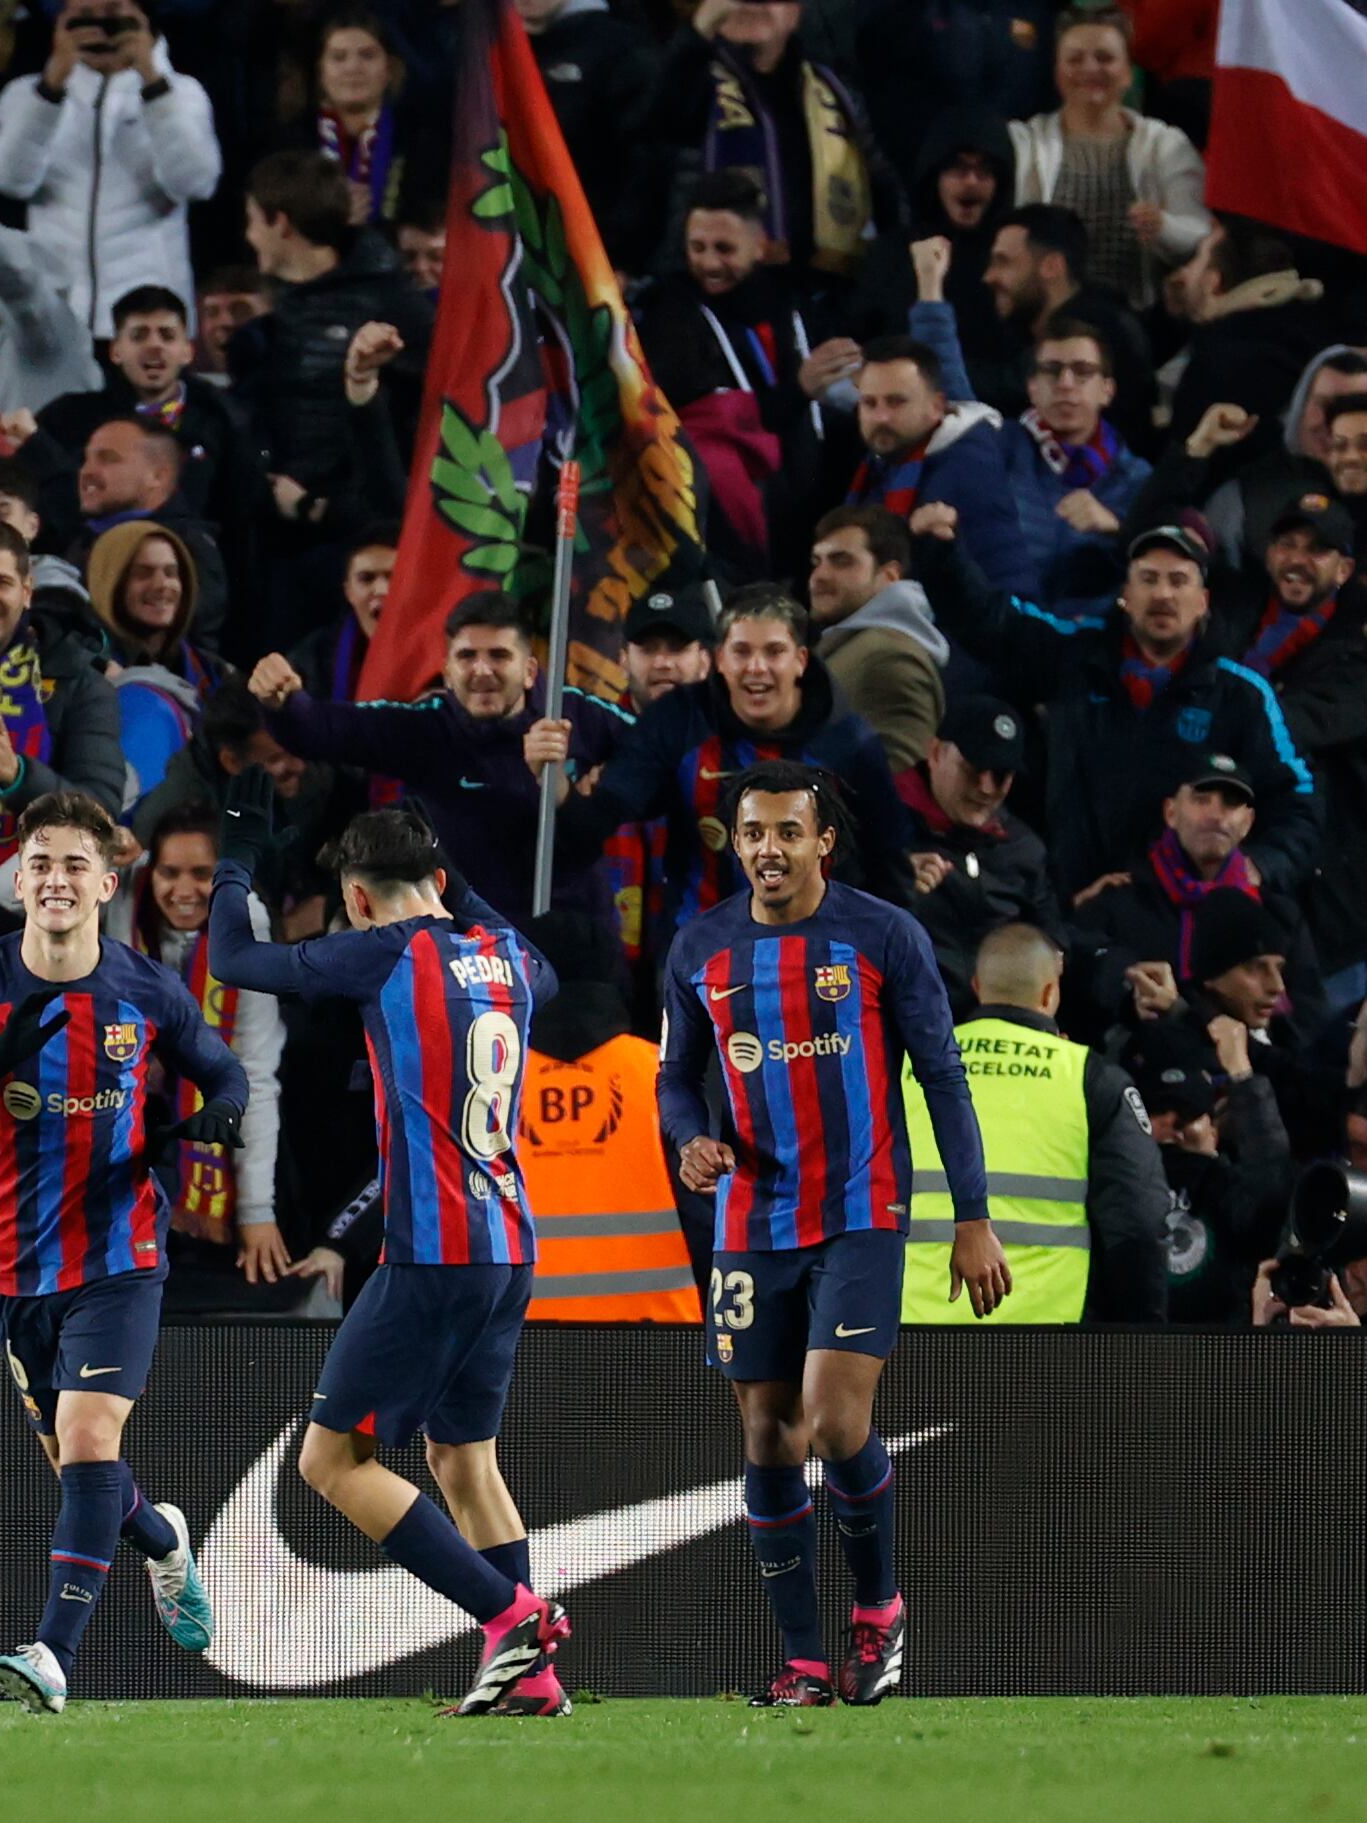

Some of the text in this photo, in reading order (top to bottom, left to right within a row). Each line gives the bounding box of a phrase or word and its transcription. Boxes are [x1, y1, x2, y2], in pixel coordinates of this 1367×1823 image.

[449, 954, 514, 988] PEDRI
[768, 1032, 852, 1064] Spotify
[959, 1038, 1059, 1059] URETAT
[47, 1088, 127, 1116] Spotify
[461, 1011, 520, 1161] 8
[539, 1084, 595, 1123] BP
[711, 1267, 754, 1330] 23
